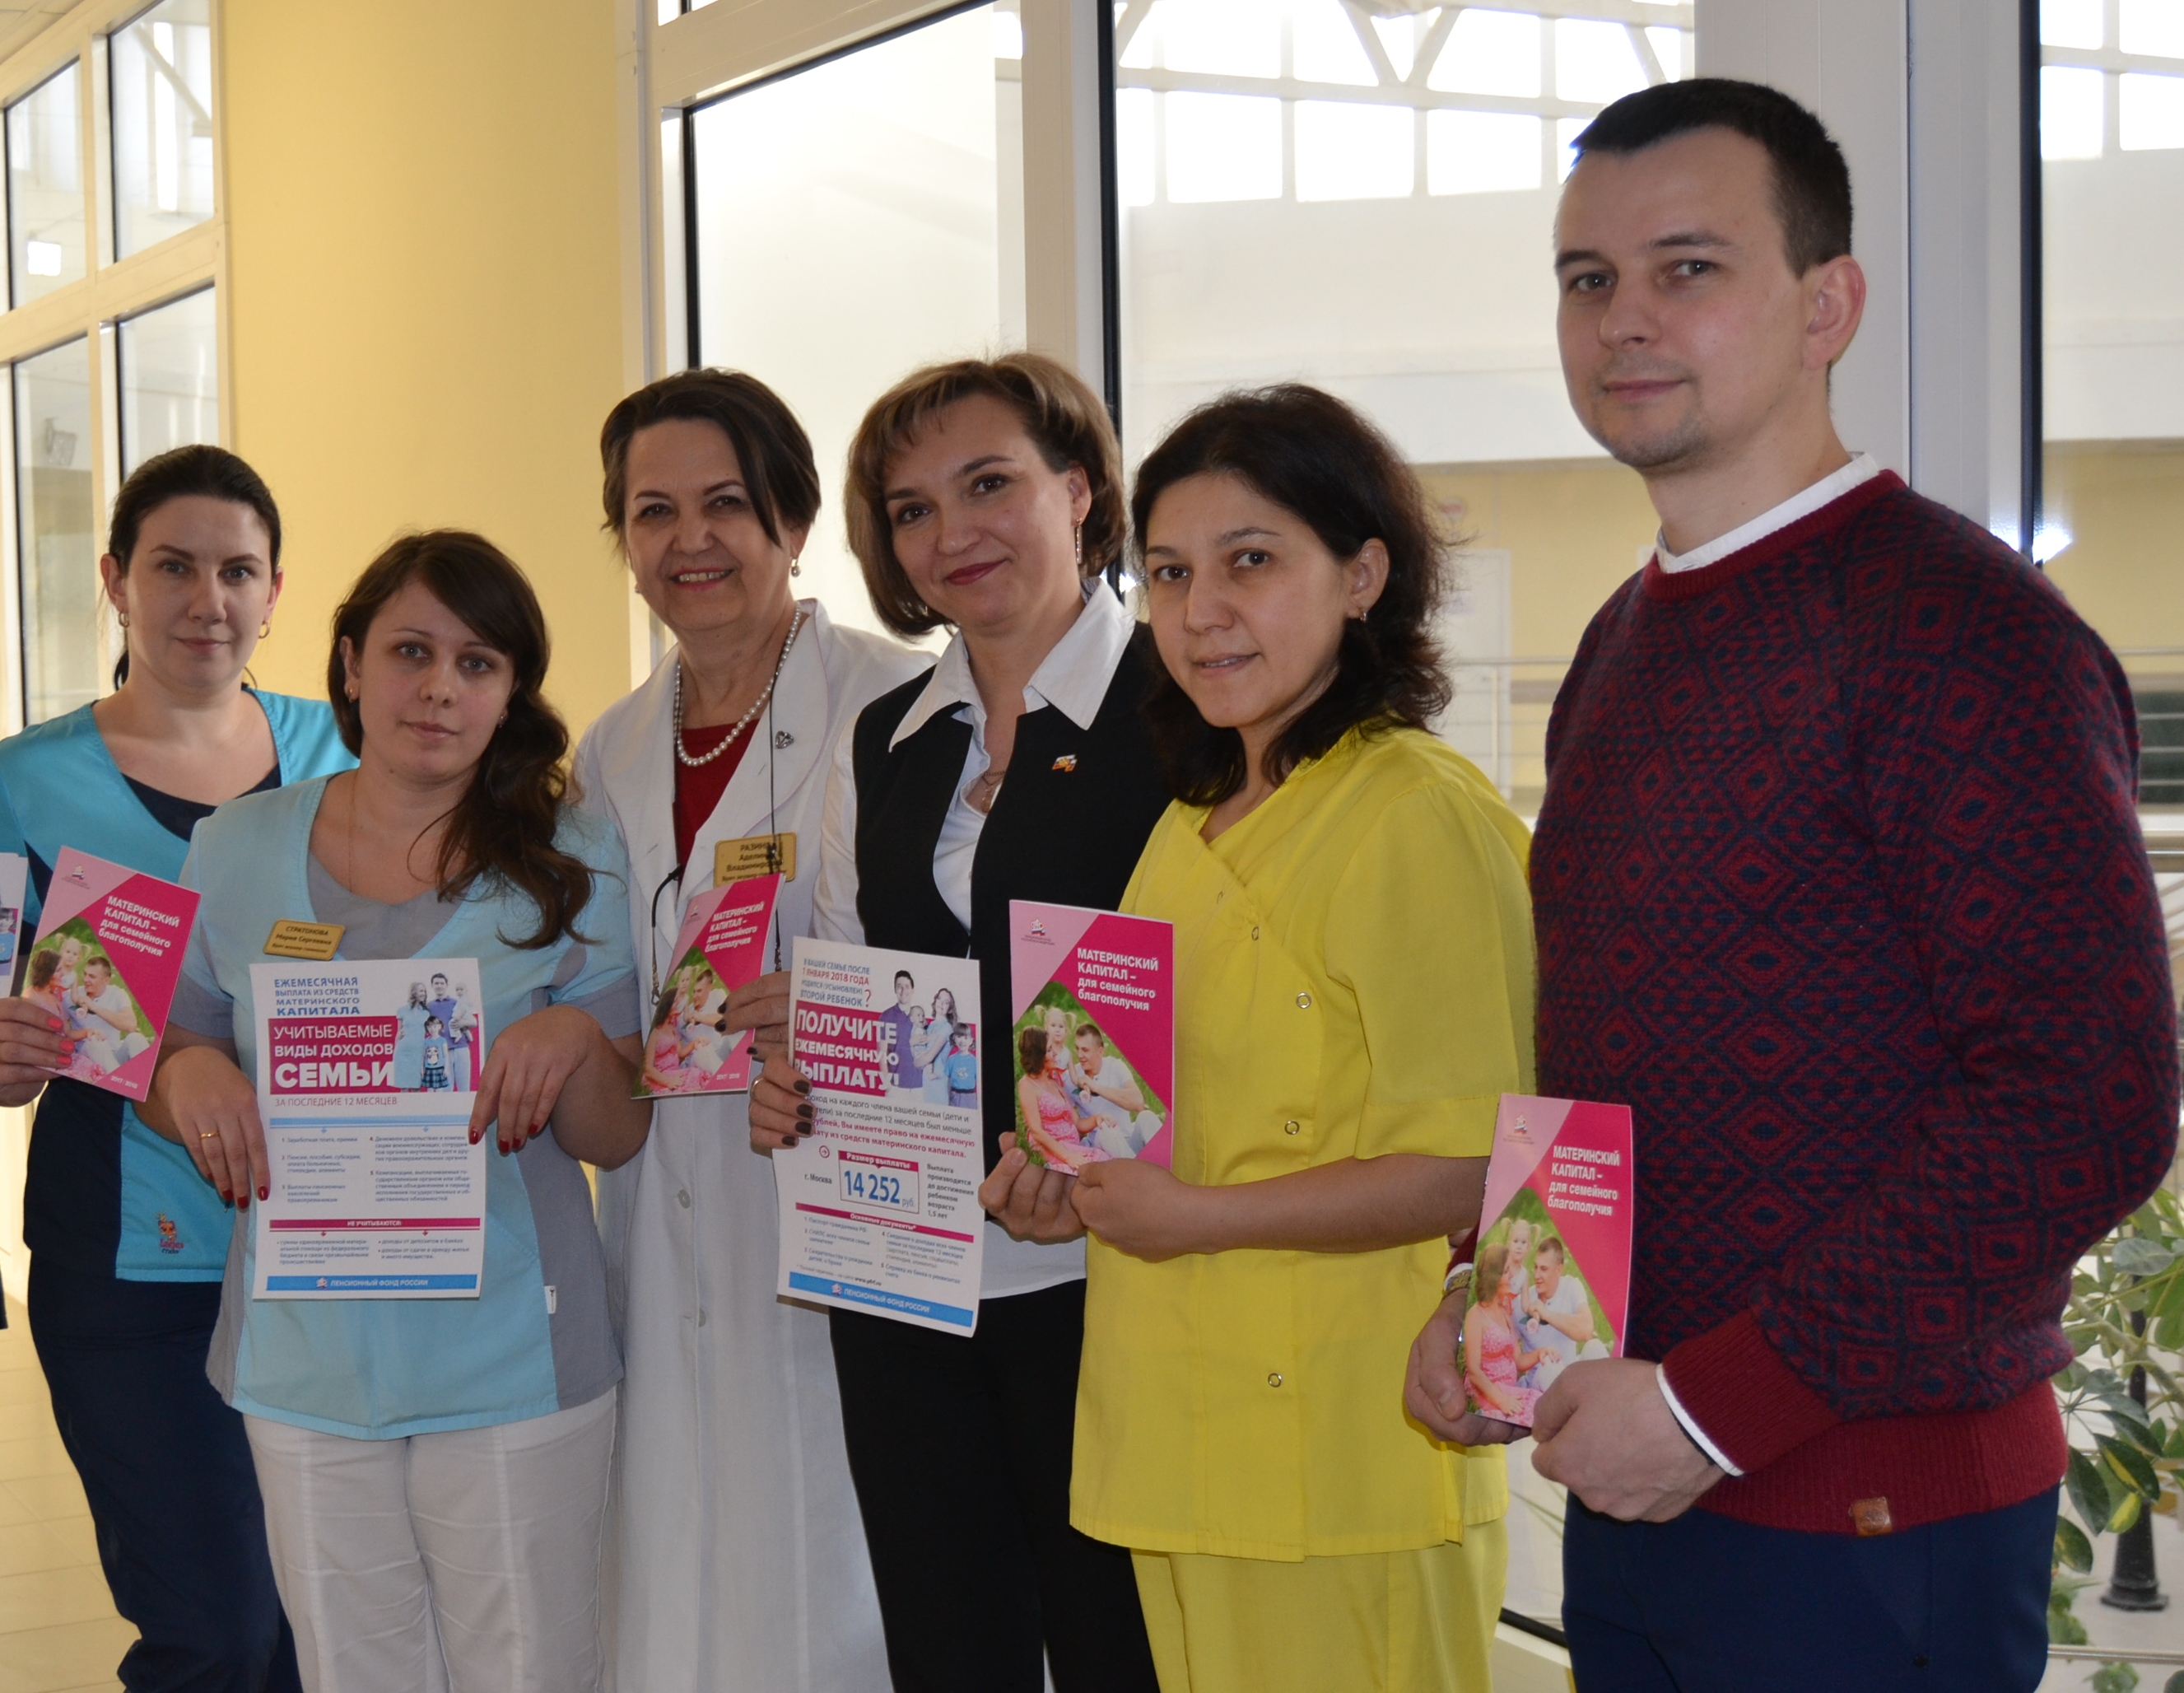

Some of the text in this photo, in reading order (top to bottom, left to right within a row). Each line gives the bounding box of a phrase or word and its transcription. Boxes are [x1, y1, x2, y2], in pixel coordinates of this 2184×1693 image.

[105, 907, 150, 929] КАПИТАЛ
[107, 896, 179, 927] МАТЕРИНСКИЙ
[712, 901, 765, 921] МАТЕРИНСКИЙ
[710, 917, 743, 932] КАПИТАЛ
[99, 928, 163, 956] благополучия
[100, 920, 170, 948] для семейного
[706, 926, 757, 944] для семейного
[705, 937, 752, 953] благополучия
[808, 959, 826, 968] ВАШЕЙ
[827, 962, 846, 971] СЕМЬЕ
[848, 965, 870, 974] ПОСЛЕ
[1078, 948, 1158, 971] МАТЕРИНСКИЙ
[807, 968, 829, 978] ЯНВАРЯ
[831, 972, 848, 982] 2018
[850, 976, 869, 986] ГОДА
[1078, 963, 1128, 980] КАПИТАЛ
[274, 977, 358, 988] ЕЖЕМЕСЯЧНАЯ
[1078, 977, 1156, 999] для семейного
[800, 990, 825, 1001] ВТОРОЙ
[827, 994, 862, 1006] РЕБЕНОК
[1078, 988, 1150, 1011] благополучия
[277, 1006, 360, 1016] КАПИТАЛА
[274, 1024, 393, 1039] УЧИТЫВАЕМЫЕ
[796, 1009, 896, 1045] ПОЛУЧИТЕ
[275, 1043, 393, 1058] ВИДЫ ДОХОДОВ
[795, 1038, 899, 1066] ЕЖЕМЕСЯЧНУЮ
[275, 1061, 393, 1088] СЕМЬИ
[275, 1098, 286, 1107] ЗА
[288, 1098, 342, 1107] ПОСЛЕДНИЕ
[356, 1097, 397, 1107] МЕСЯЦЕВ
[840, 1100, 869, 1108] каждого
[871, 1103, 892, 1112] члена
[894, 1106, 917, 1115] вашей
[919, 1110, 941, 1118] семьи
[943, 1112, 962, 1122] (дети
[845, 1112, 882, 1122] последние
[894, 1118, 925, 1128] месяцев
[926, 1121, 941, 1131] был
[942, 1126, 971, 1135] меньше
[841, 1121, 853, 1130] Вы
[855, 1125, 882, 1133] имеете
[884, 1128, 907, 1136] право
[920, 1133, 975, 1148] ежемесячную
[841, 1133, 870, 1143] средств
[872, 1139, 926, 1152] материнского
[928, 1146, 966, 1158] капитала.
[846, 1153, 910, 1169] Размер выплаты
[1553, 1145, 1620, 1166] МАТЕРИНСКИЙ
[927, 1164, 953, 1173] Выплата
[1551, 1163, 1595, 1181] КАПИТАЛ
[810, 1173, 832, 1184] Москва
[927, 1174, 971, 1186] производится
[844, 1170, 915, 1208] 14 252 руб.
[928, 1192, 958, 1202] ребенком
[936, 1184, 974, 1196] достижения
[1548, 1182, 1618, 1201] для семейного
[928, 1202, 955, 1210] возраста
[1548, 1194, 1613, 1216] благополучия
[844, 1288, 931, 1313] ПЕНСИОННЫЙ ФОНД РОССИИ
